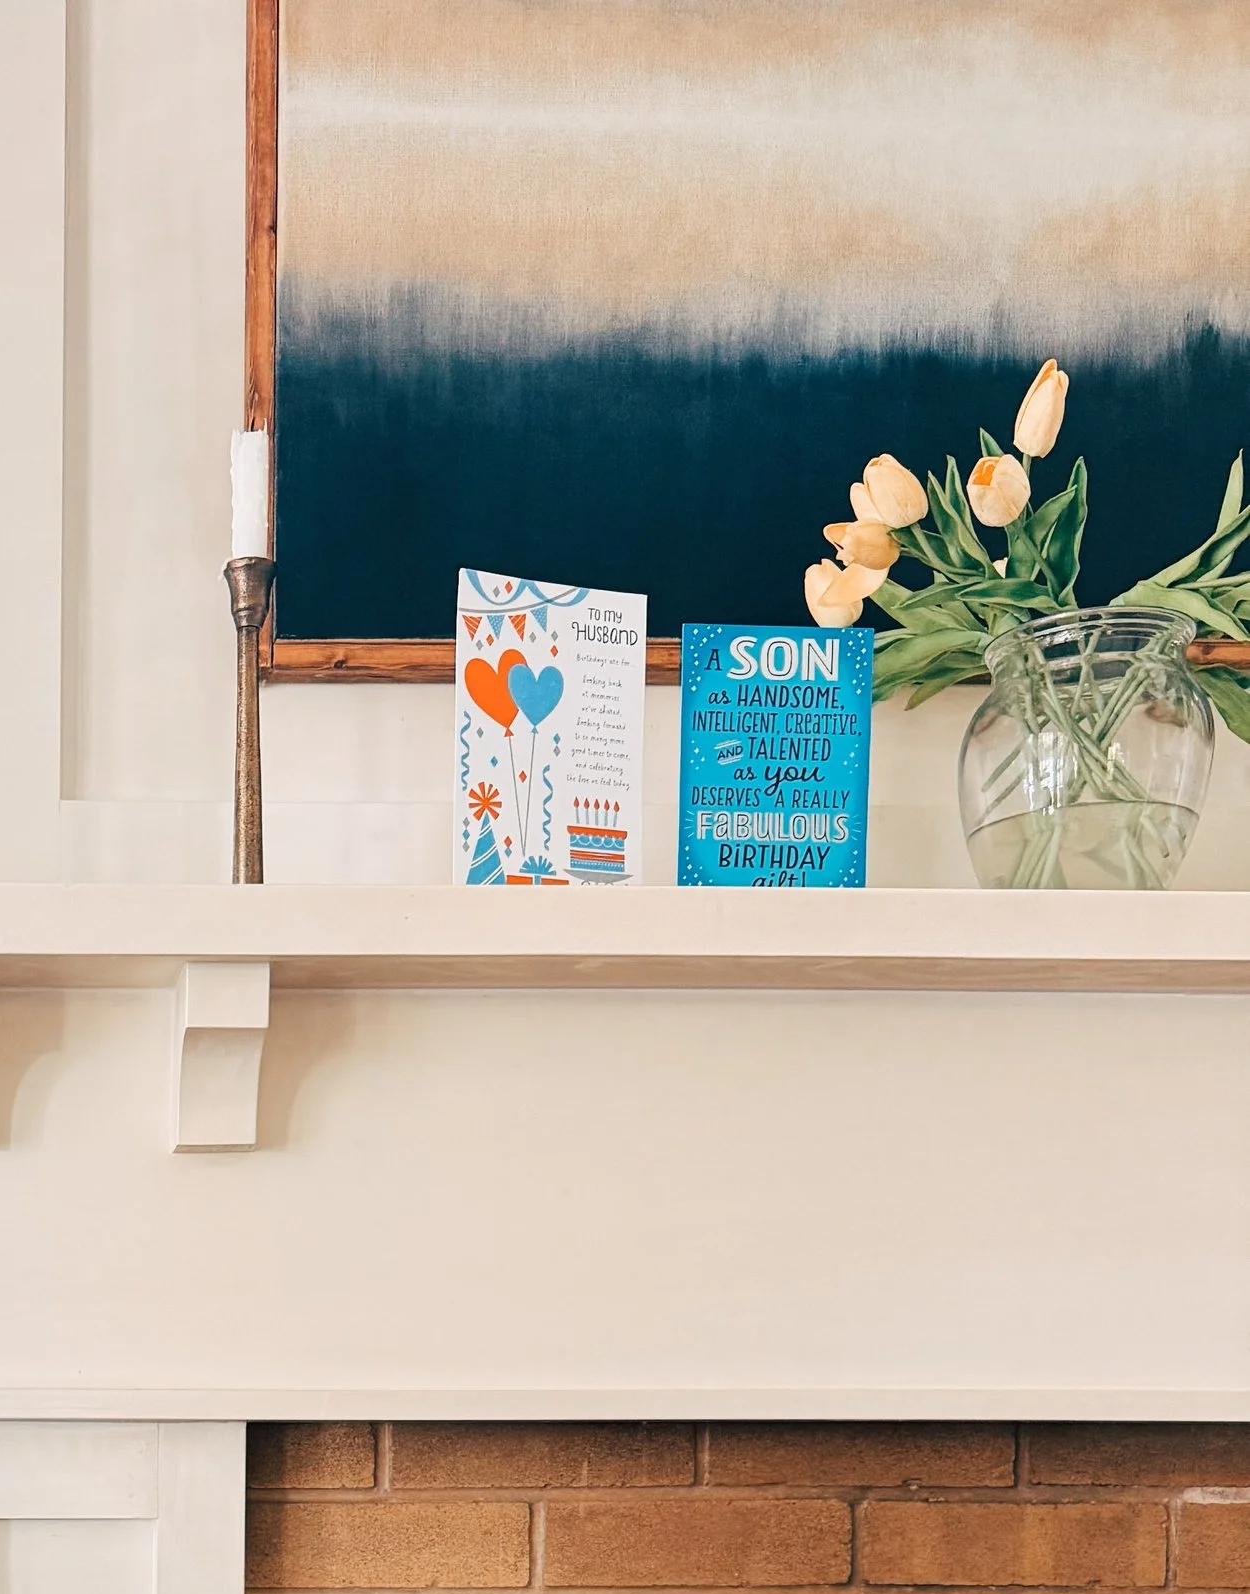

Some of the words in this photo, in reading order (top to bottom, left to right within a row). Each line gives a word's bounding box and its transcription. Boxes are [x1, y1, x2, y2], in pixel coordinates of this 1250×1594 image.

[704, 648, 722, 671] A
[726, 635, 840, 682] SON
[708, 689, 732, 705] as
[737, 684, 845, 711] HANDSOME,
[717, 745, 744, 761] AND
[748, 736, 831, 762] TALENTED
[589, 763, 623, 776] celebrating
[733, 767, 757, 781] as
[764, 764, 825, 797] you
[691, 786, 762, 808] DESERVES
[774, 791, 785, 808] A
[792, 789, 850, 809] REALLY
